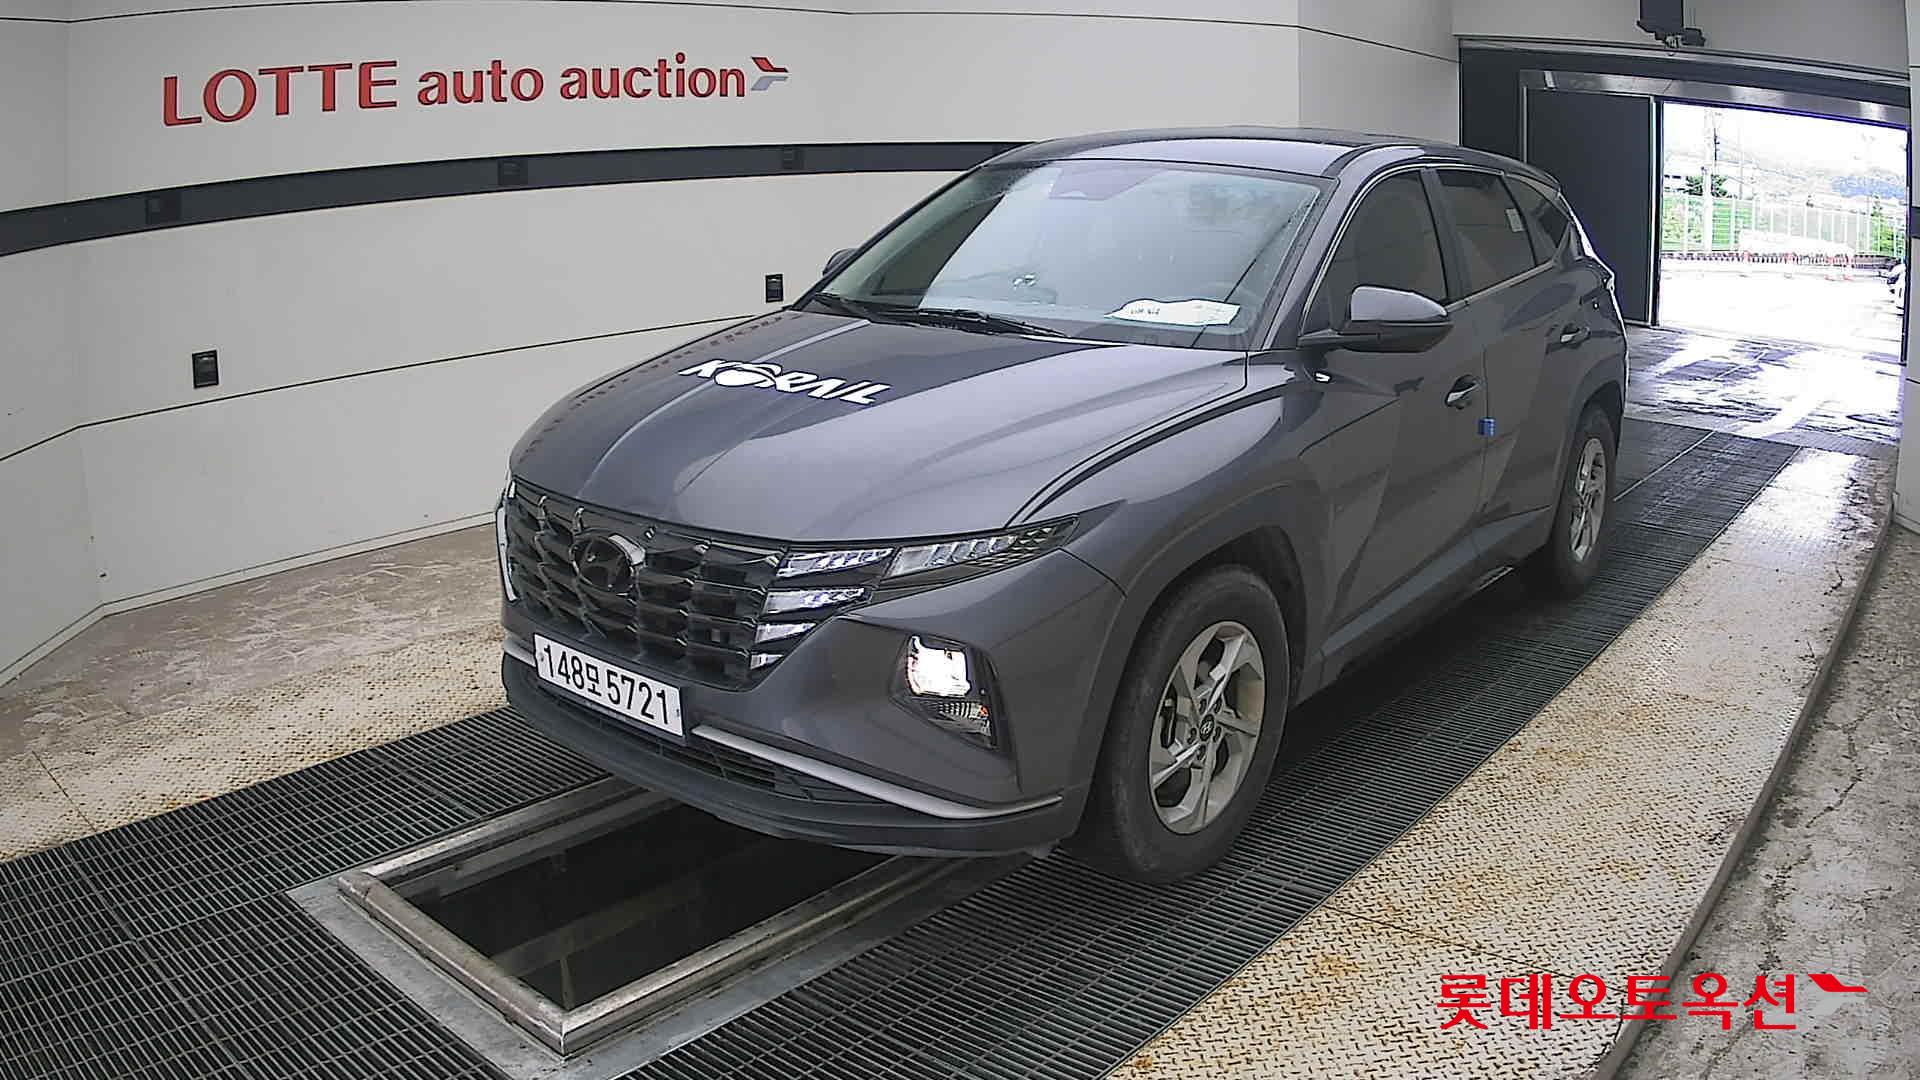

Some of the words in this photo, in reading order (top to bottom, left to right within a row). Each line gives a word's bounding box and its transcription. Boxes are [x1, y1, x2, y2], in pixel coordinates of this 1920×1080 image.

[163, 60, 398, 126] LOTTE
[417, 61, 545, 106] auto
[559, 52, 747, 99] auction
[678, 358, 892, 405] KORAIL
